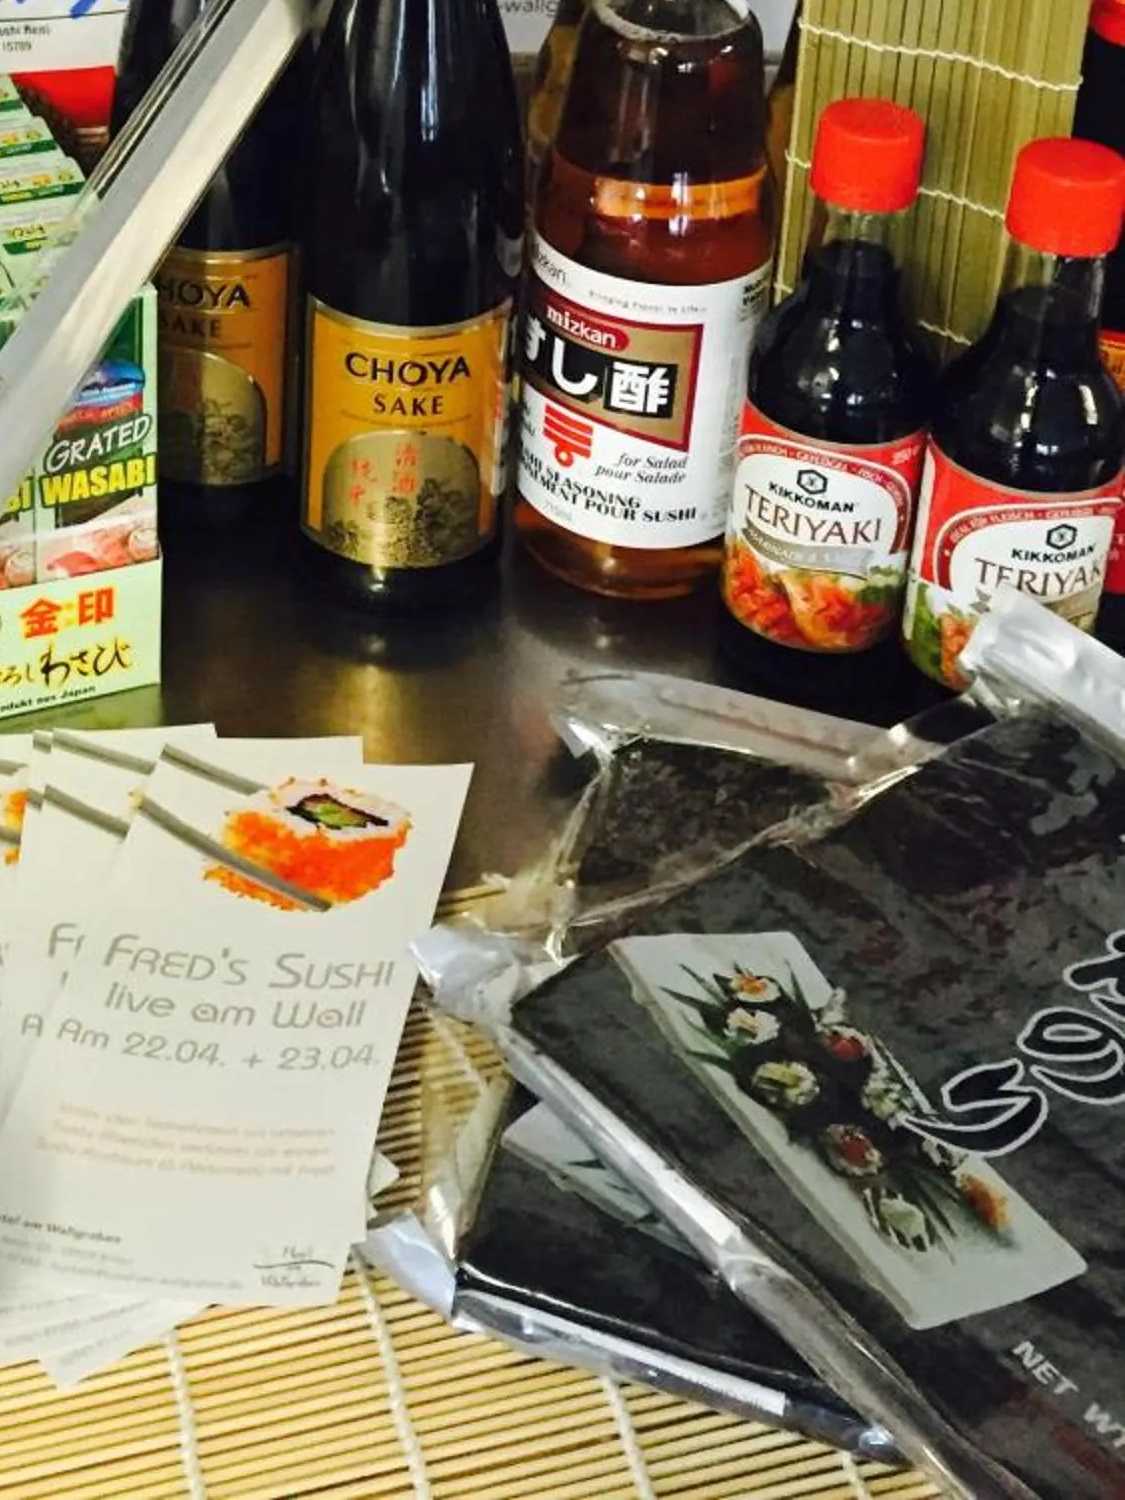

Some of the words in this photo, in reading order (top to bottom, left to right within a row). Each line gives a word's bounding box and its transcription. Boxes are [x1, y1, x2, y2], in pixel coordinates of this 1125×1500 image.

[158, 278, 251, 310] HOYA
[546, 305, 617, 348] mizkan
[344, 352, 472, 388] CHOYA
[373, 391, 444, 417] SAKE
[45, 415, 151, 474] GRATED
[616, 452, 641, 469] for
[645, 454, 688, 469] Salad
[41, 454, 156, 508] WASABI
[546, 464, 642, 510] SEASONING
[595, 464, 629, 481] pour
[633, 469, 687, 485] Salade
[585, 500, 636, 522] POUR
[642, 506, 697, 523] SUSHI
[744, 483, 882, 545] TERIYAKI
[768, 480, 855, 514] KIKKOMAN
[1011, 543, 1097, 565] KIKKOMAN
[103, 932, 250, 986] FRED'S
[267, 951, 396, 991] SUSHI
[104, 981, 176, 1019] live
[190, 1001, 255, 1028] am
[272, 999, 369, 1030] Wall
[56, 1016, 110, 1051] Am
[118, 1031, 227, 1069] 22.04.
[276, 1042, 380, 1072] 23.04.
[1011, 1340, 1080, 1395] NET
